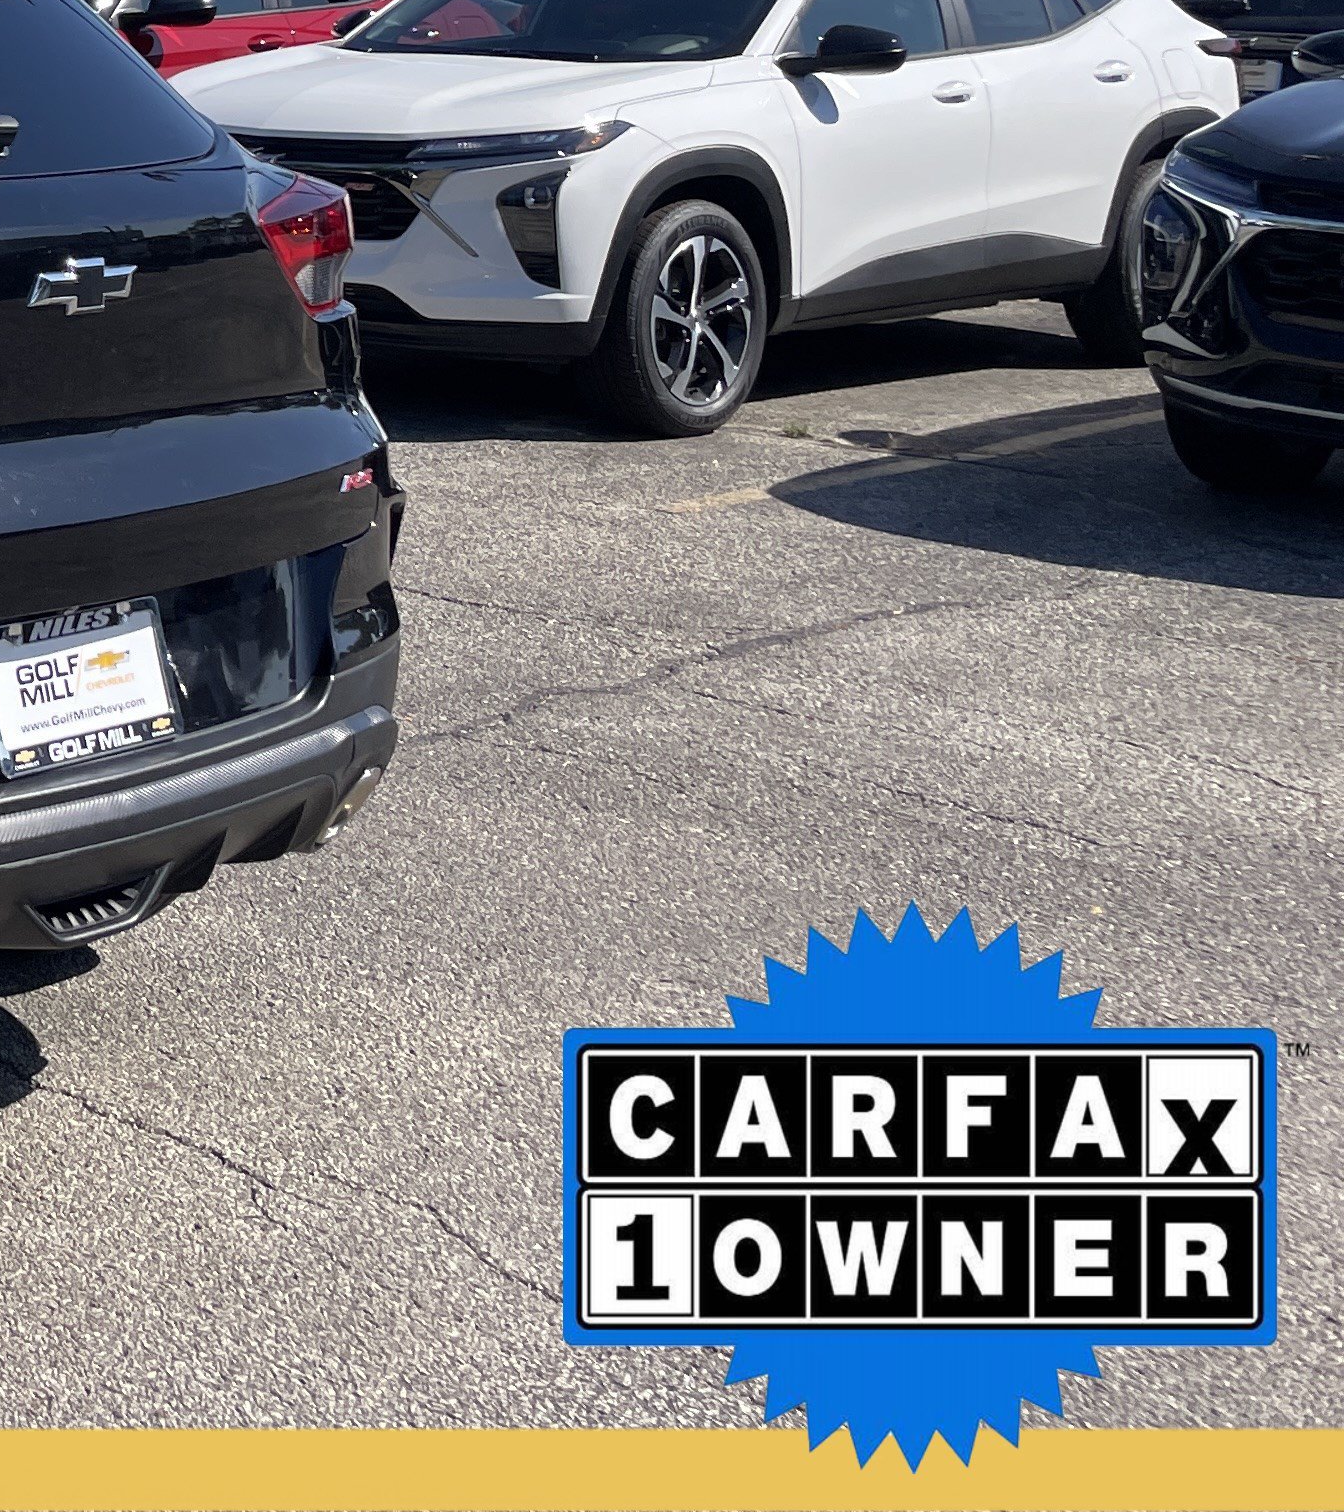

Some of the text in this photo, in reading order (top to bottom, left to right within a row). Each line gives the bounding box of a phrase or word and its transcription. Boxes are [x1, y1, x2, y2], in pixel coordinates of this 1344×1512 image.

[340, 468, 373, 493] RS
[28, 606, 112, 643] NILES
[15, 653, 80, 686] GOLF
[19, 678, 75, 708] MILL
[20, 696, 146, 734] www.GolfMillChevy.com
[48, 724, 143, 763] GOLF MILL
